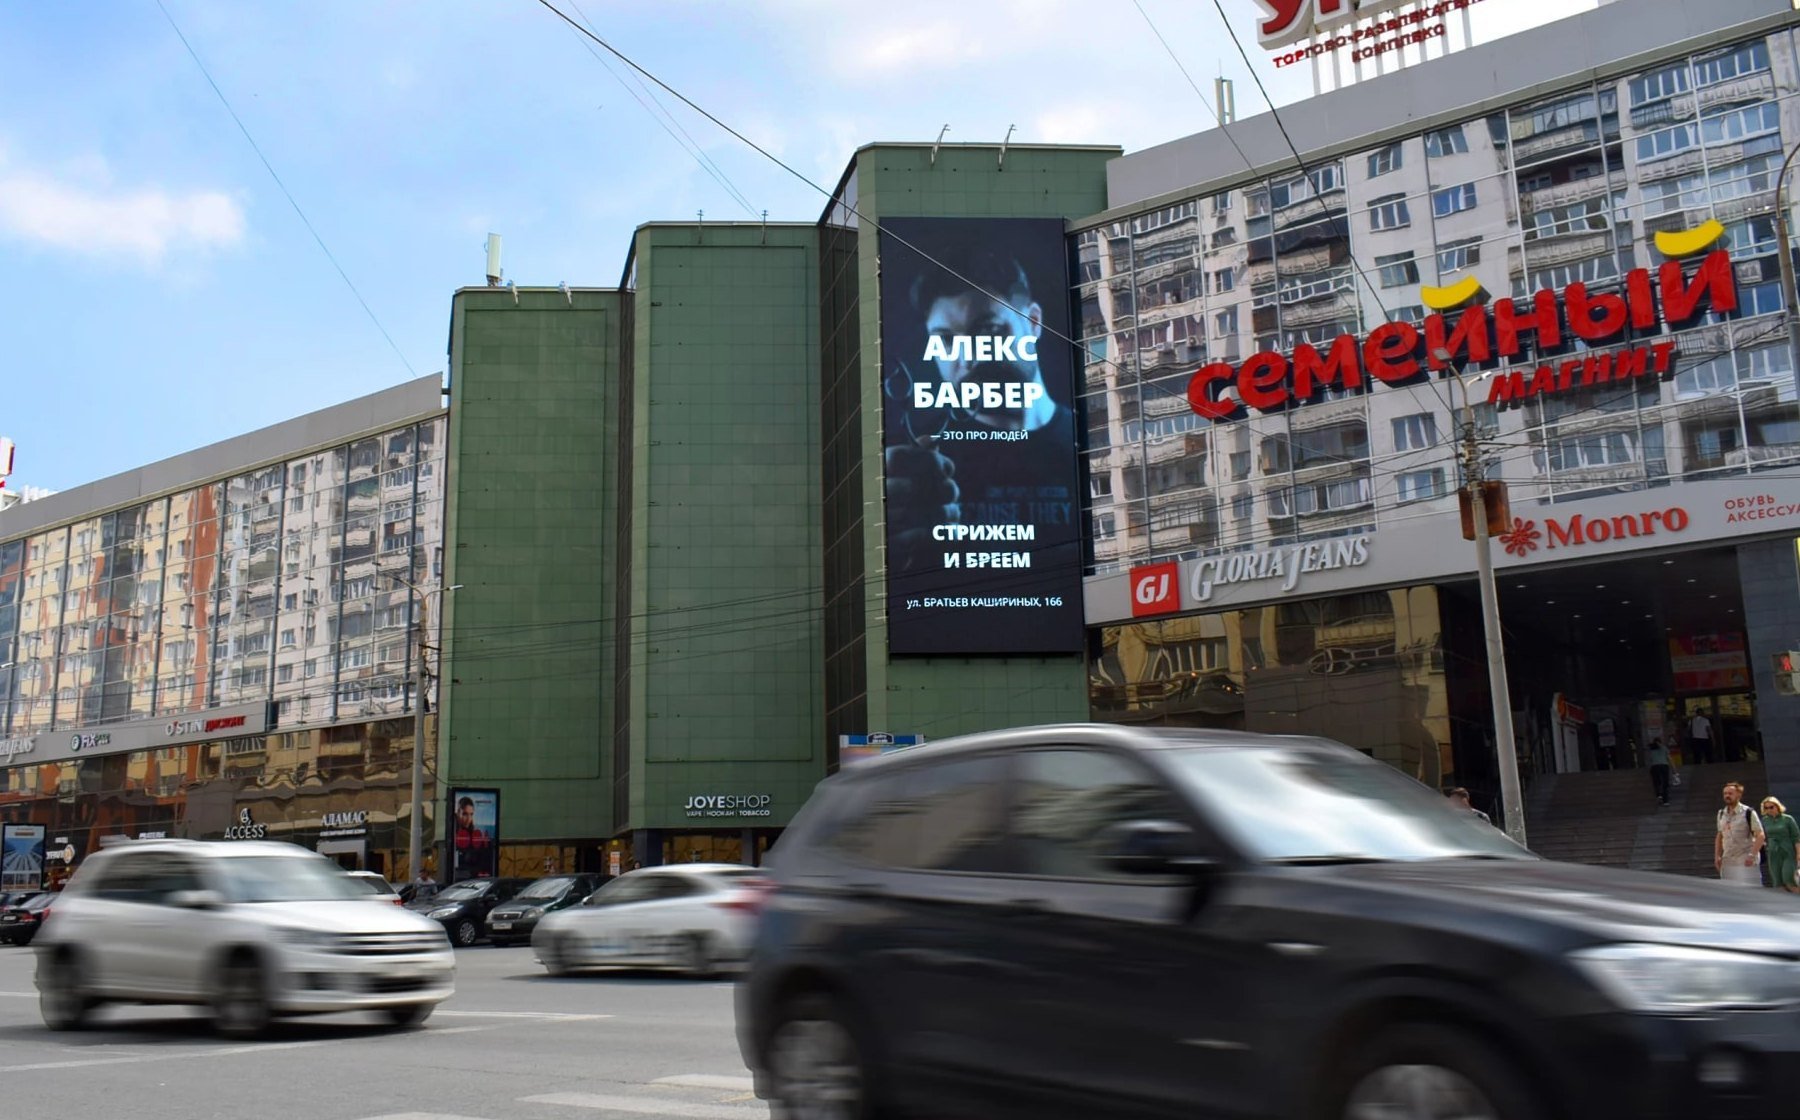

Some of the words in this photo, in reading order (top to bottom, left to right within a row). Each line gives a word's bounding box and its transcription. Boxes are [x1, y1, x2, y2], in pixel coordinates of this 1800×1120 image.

[1273, 0, 1486, 68] ТОРГОВО-РАЗВЛЕКАТЕ
[1352, 23, 1445, 63] КОМПЛЕКС
[923, 335, 1038, 361] АЛЕКС
[1487, 341, 1675, 405] МАГНИТ
[913, 382, 1043, 409] БАРБЕР
[943, 431, 963, 440] ЭТО
[966, 431, 987, 440] ПРО
[989, 429, 1029, 442] ЛЮДЕЙ
[1724, 494, 1775, 510] ОБУВЬ
[932, 524, 1035, 541] СТРИЖЕМ
[1544, 507, 1688, 549] Monro
[943, 552, 960, 568] И
[965, 552, 1031, 568] БРЕЕМ
[1136, 573, 1169, 605] GJ
[906, 598, 922, 609] ул.
[924, 598, 969, 607] БРАТЬЕВ
[970, 597, 1042, 608] КАШИРИНЫХ,
[1045, 597, 1063, 606] 166
[684, 794, 770, 809] JOYESHOP
[224, 823, 265, 840] ACCESS
